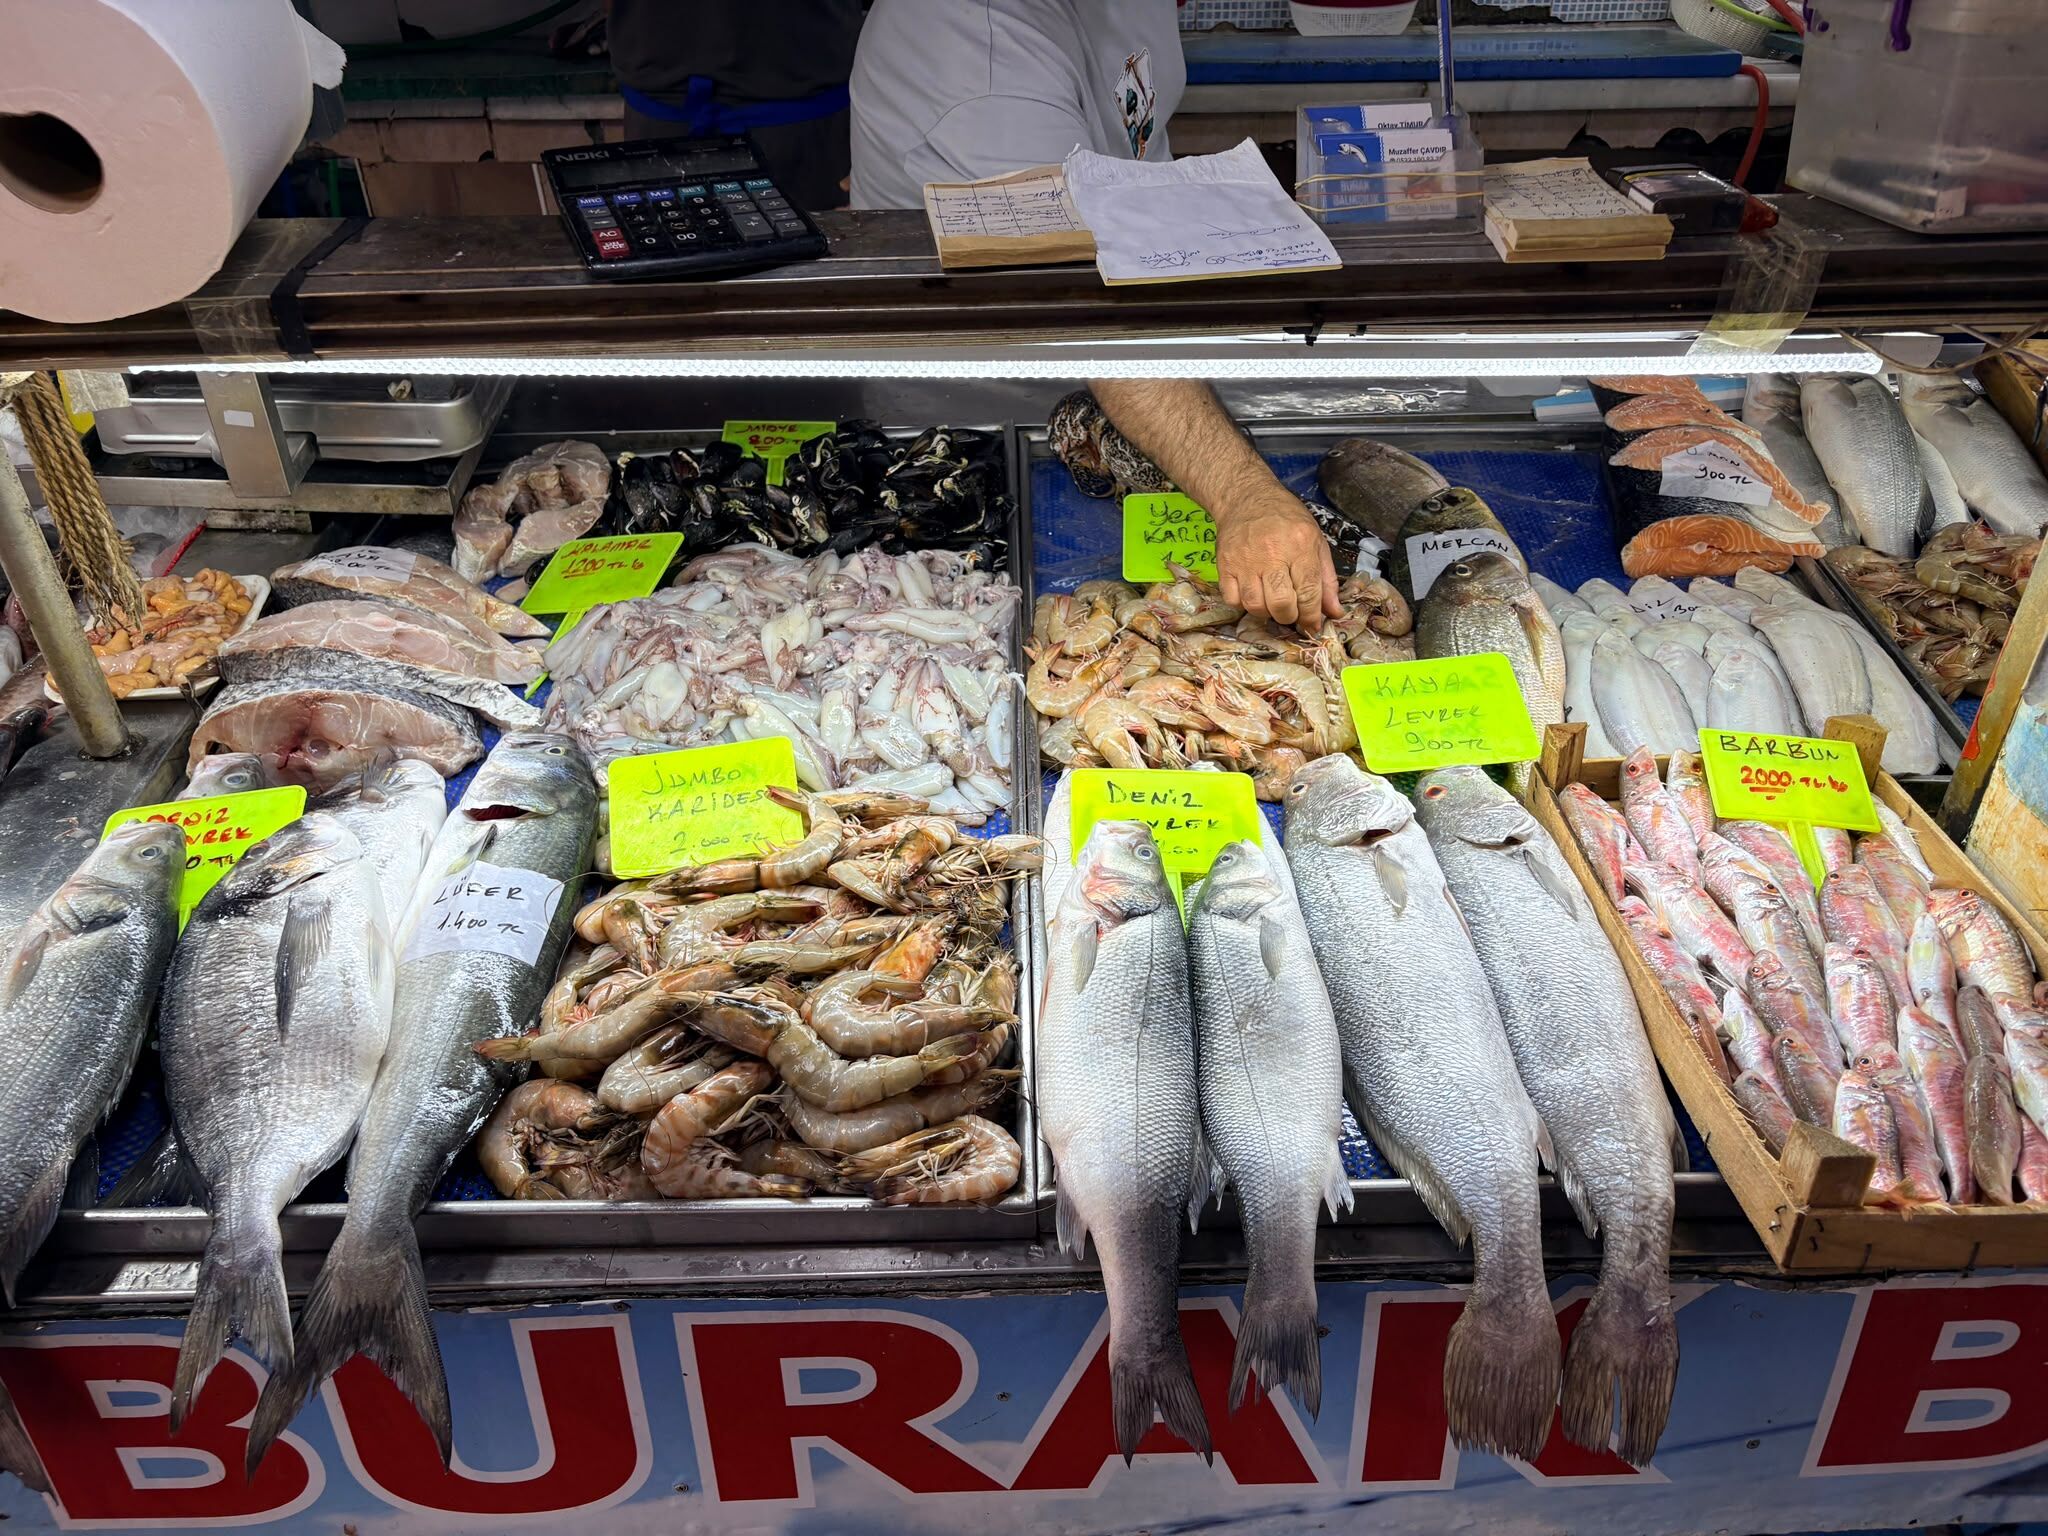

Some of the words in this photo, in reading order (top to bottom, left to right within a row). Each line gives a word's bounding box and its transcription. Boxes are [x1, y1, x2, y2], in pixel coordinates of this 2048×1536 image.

[1388, 147, 1419, 155] Muzaffer
[1420, 146, 1447, 155] ÇAVDIR
[600, 230, 618, 238] AC
[1422, 537, 1509, 553] MERCAN
[1375, 672, 1460, 697] KAYA
[1720, 735, 1839, 761] BARBUN
[433, 875, 525, 905] LÜFER
[437, 910, 488, 931] 1.400
